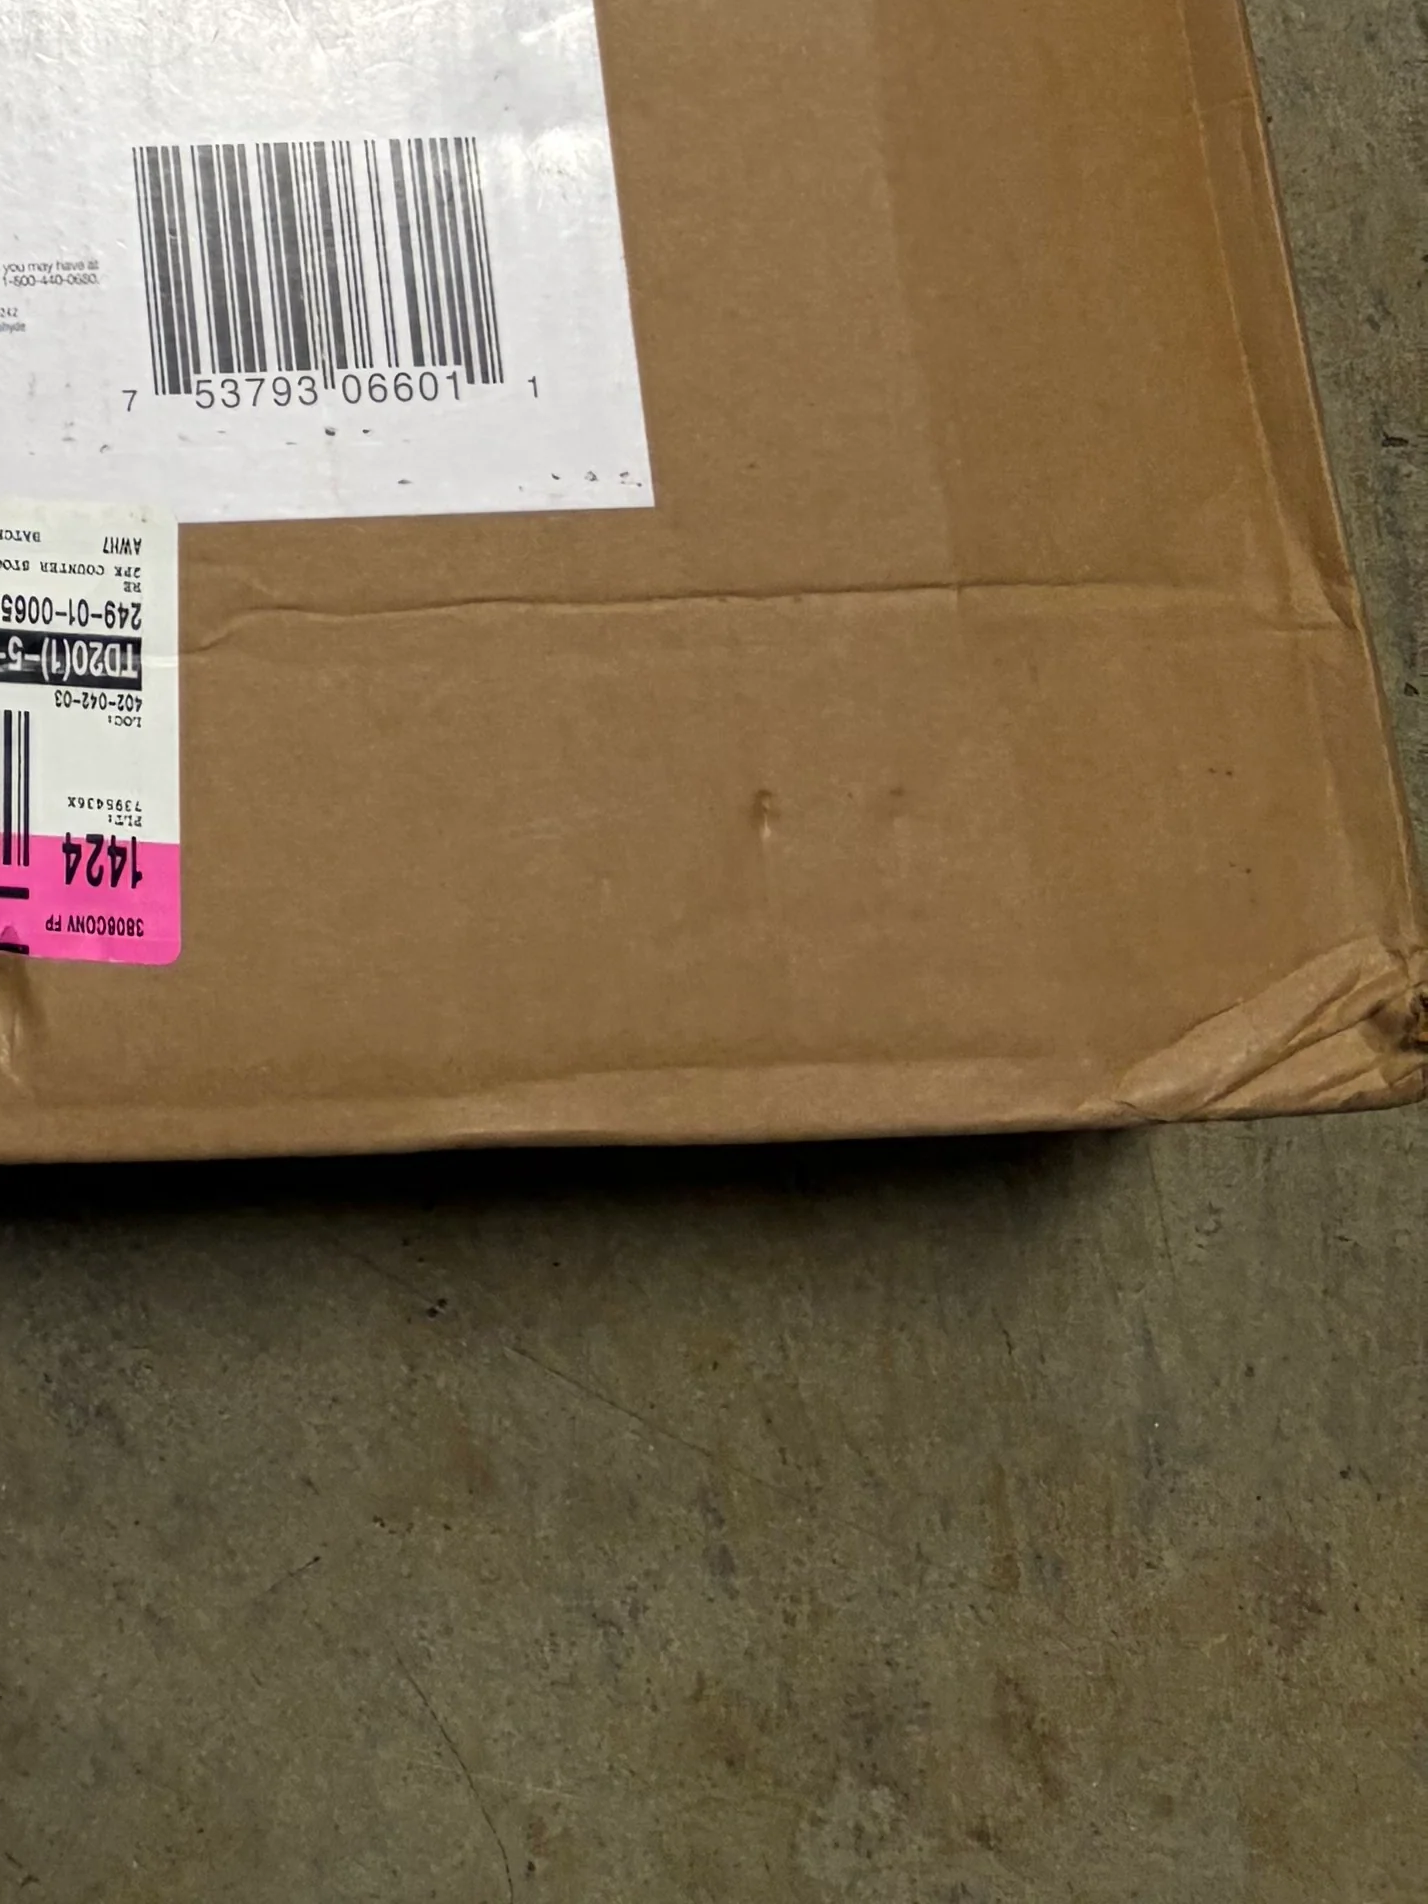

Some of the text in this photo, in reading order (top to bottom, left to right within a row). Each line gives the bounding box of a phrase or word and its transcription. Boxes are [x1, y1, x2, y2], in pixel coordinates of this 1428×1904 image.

[3, 263, 25, 275] you
[28, 262, 53, 273] may
[56, 260, 85, 271] have
[88, 259, 99, 270] at
[122, 371, 539, 413] 7 53793 06601 1
[103, 536, 142, 555] AWH7
[40, 560, 105, 576] COUNTER
[115, 566, 141, 578] 2PK
[124, 582, 142, 593] RE
[1, 594, 142, 630] 249-01-0065
[55, 690, 142, 712] 402-042-03
[108, 716, 142, 728] LOC:
[62, 832, 142, 889] 1424
[45, 914, 62, 932] FP
